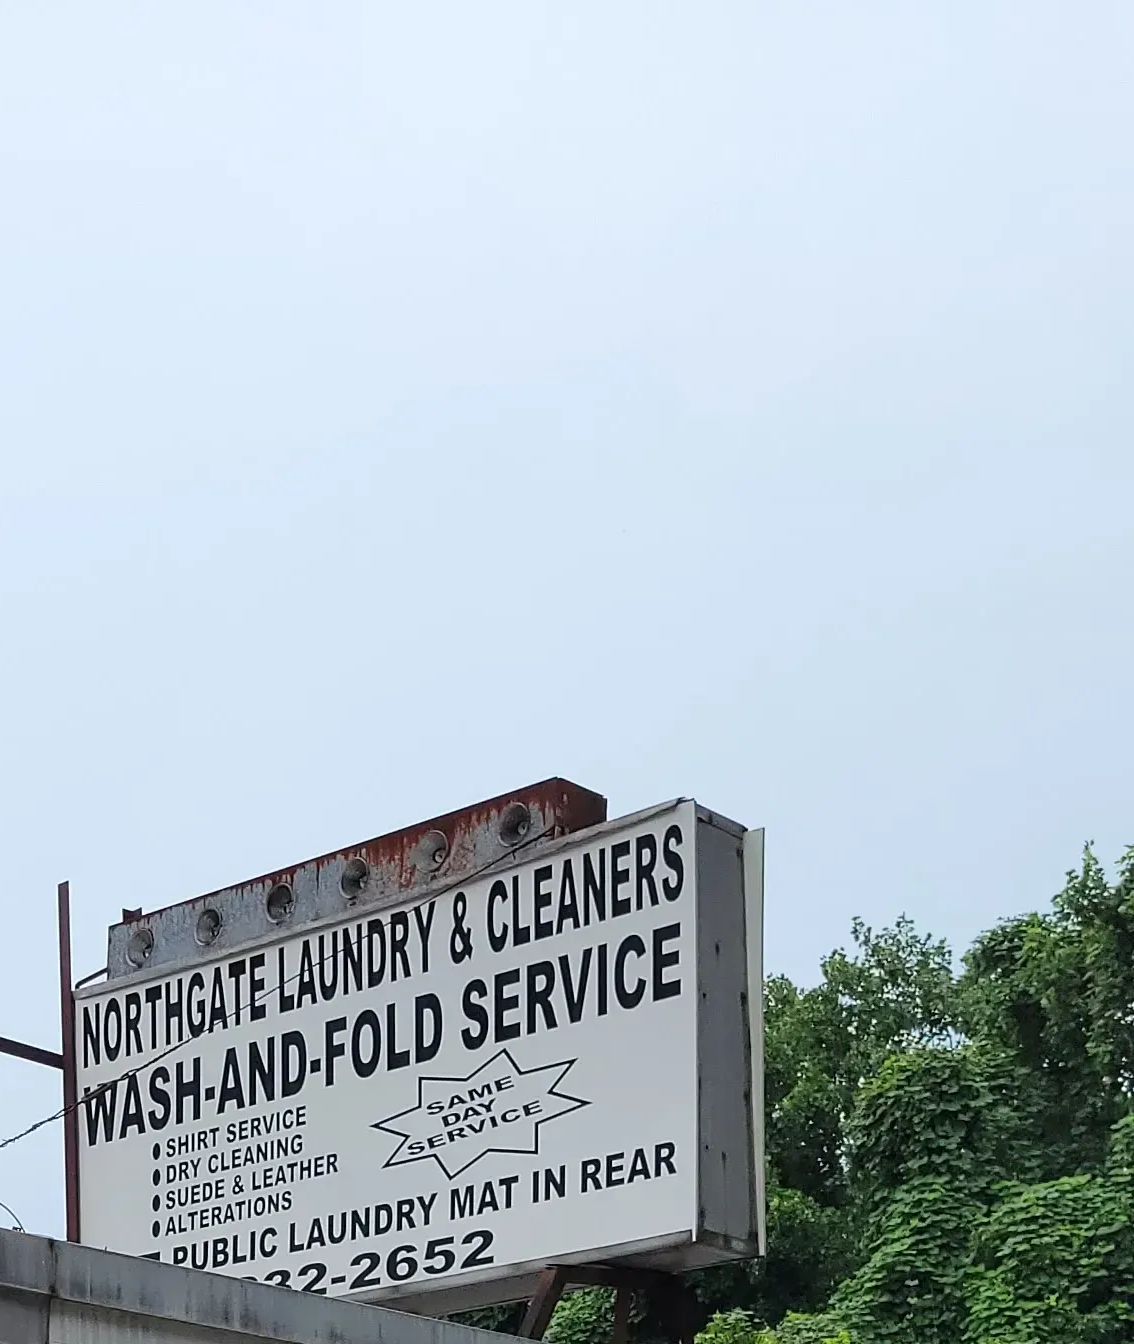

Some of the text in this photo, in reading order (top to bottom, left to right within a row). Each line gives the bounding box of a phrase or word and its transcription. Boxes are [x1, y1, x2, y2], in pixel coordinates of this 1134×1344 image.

[83, 824, 684, 1068] NORTHGATE LAUNDRY & CLEANERS
[84, 922, 681, 1147] WASH-AND-FOLD SERVICE
[426, 1076, 515, 1115] SAME
[441, 1098, 496, 1128] DAY
[166, 1105, 307, 1158] SHIRT SERVICE
[407, 1100, 543, 1155] SERVICE
[166, 1134, 303, 1184] DRY CLEANING
[166, 1153, 339, 1210] SUEDE & LEATHER
[165, 1190, 292, 1237] ALTERATIONS
[173, 1142, 677, 1270] PUBLIC LAUNDRY MAT IN REAR
